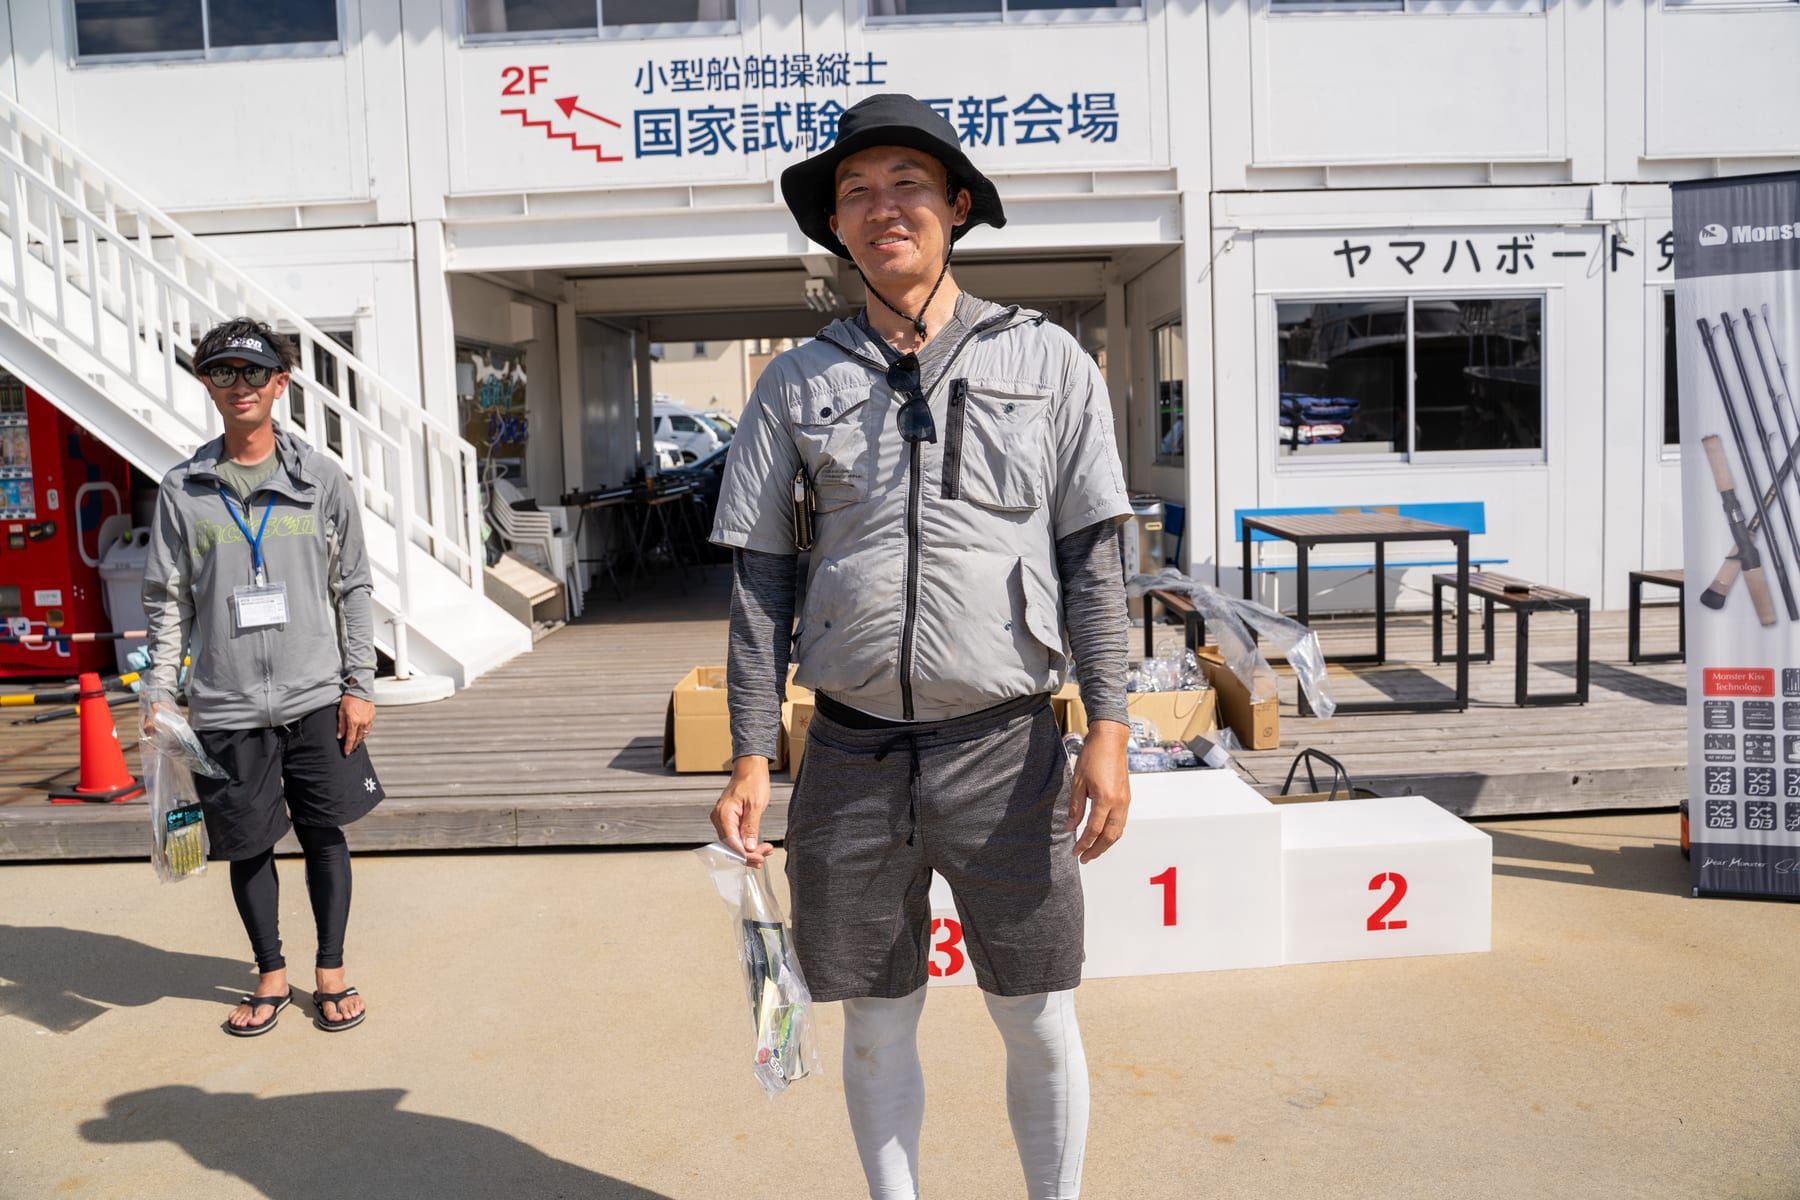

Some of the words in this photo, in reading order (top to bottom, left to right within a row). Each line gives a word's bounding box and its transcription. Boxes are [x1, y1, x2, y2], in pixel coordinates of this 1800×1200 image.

[635, 52, 888, 95] 小型船舶操縦士
[500, 65, 549, 96] 2F
[1712, 672, 1746, 681] Monster
[1748, 672, 1765, 681] Kiss
[1715, 683, 1763, 693] Technology
[1709, 783, 1731, 794] D8
[1748, 784, 1770, 795] D9
[1709, 817, 1734, 828] D12
[1749, 818, 1773, 829] D13
[1150, 866, 1177, 926] 1
[1366, 872, 1408, 931] 2
[928, 918, 964, 977] 3
